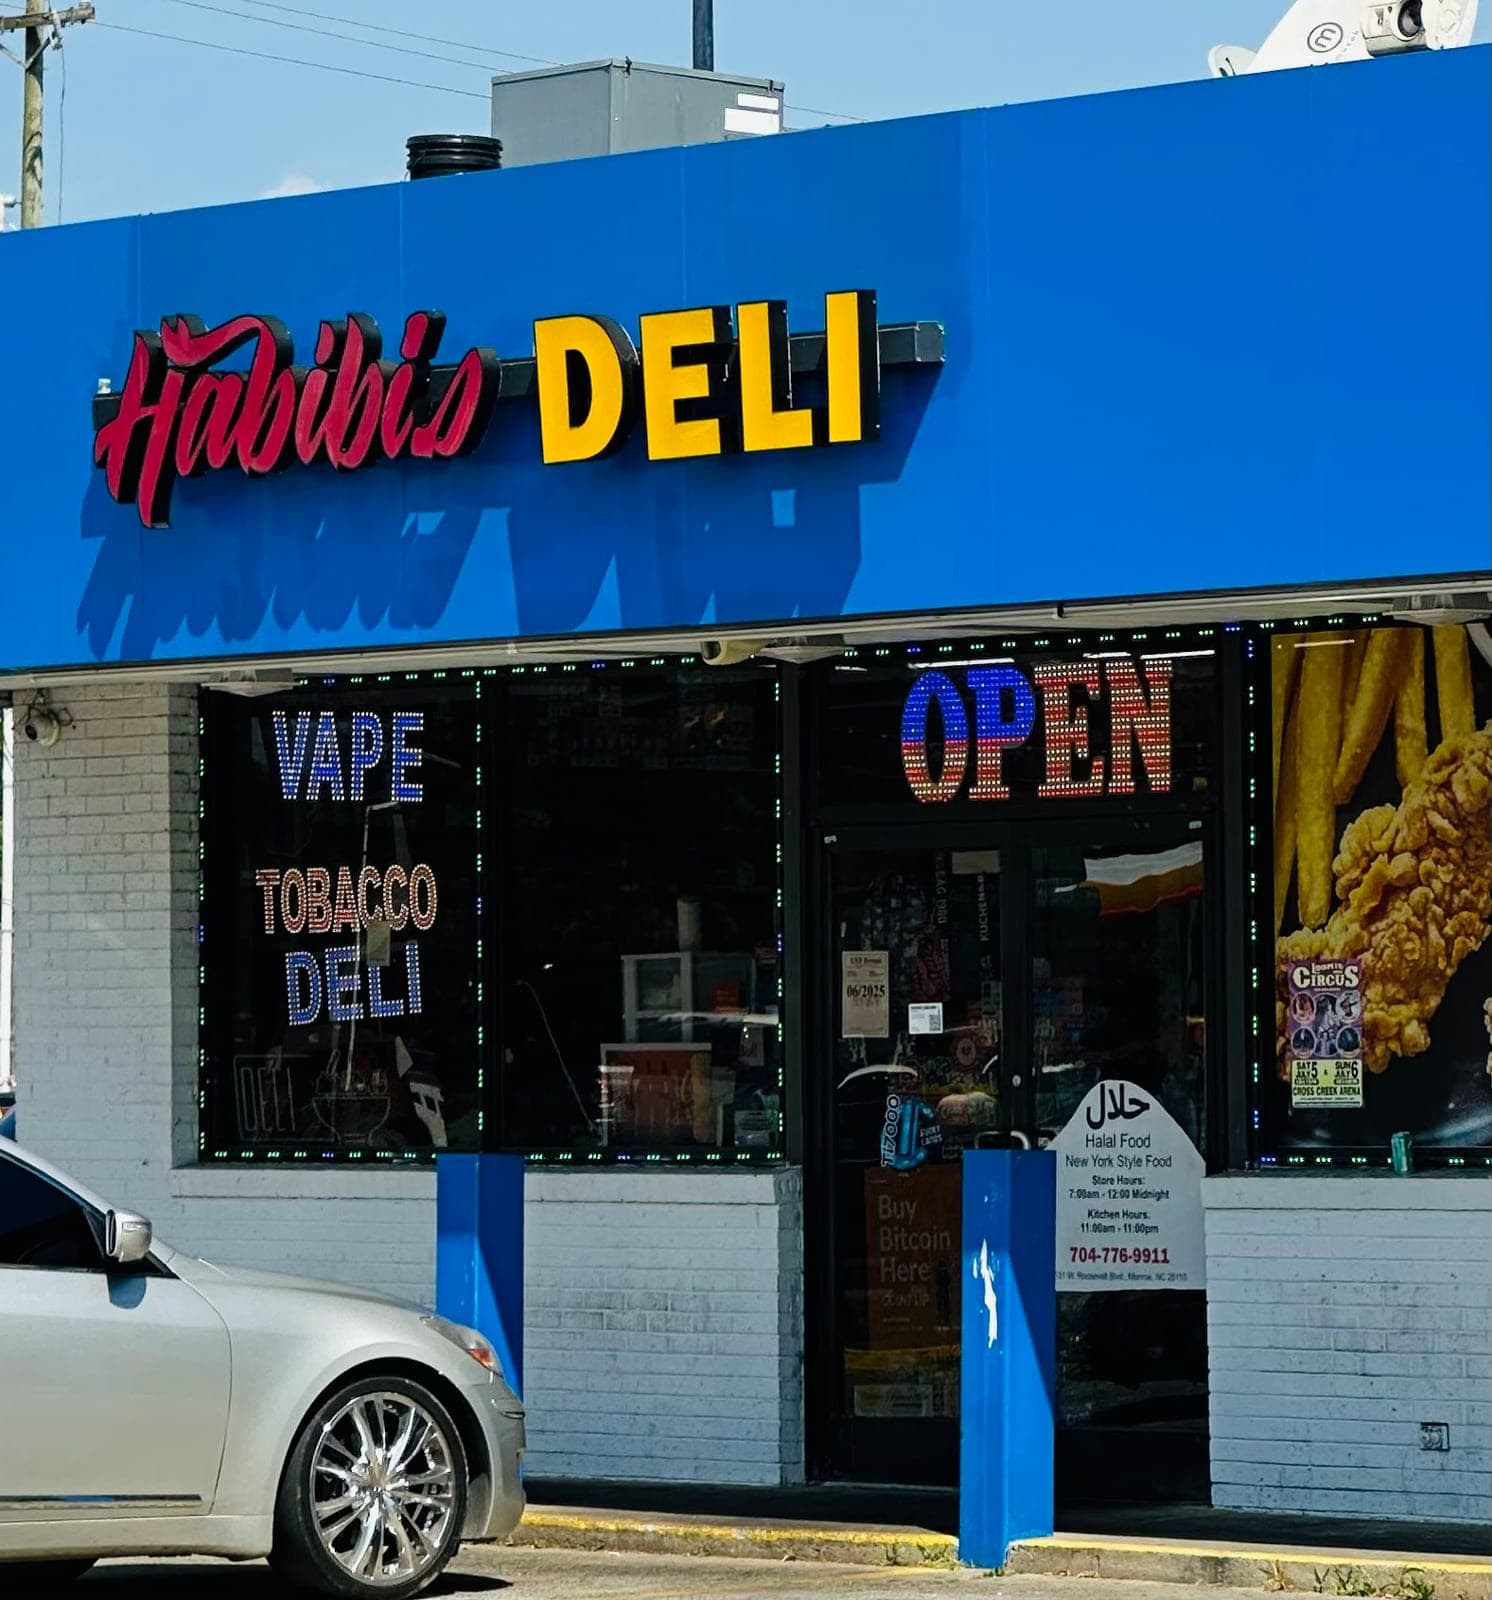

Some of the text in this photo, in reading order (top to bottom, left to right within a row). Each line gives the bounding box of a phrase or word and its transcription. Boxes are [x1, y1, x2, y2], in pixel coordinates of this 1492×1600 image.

[534, 289, 873, 465] DELI
[901, 660, 1173, 803] OPEN
[272, 711, 424, 802] VAPE
[256, 864, 438, 934] TOBACCO
[285, 943, 422, 1026] DELI
[1292, 965, 1359, 988] CIRCUS
[847, 984, 886, 998] 06/2025
[1296, 1061, 1318, 1078] SAT 5
[1351, 1061, 1358, 1078] 6
[1293, 1086, 1360, 1096] CROSS CREEK ARENA
[1087, 1083, 1150, 1130] حلال
[1086, 1132, 1151, 1148] Halal Food
[1066, 1154, 1172, 1170] New York Style Food
[1092, 1175, 1115, 1185] Store
[1069, 1189, 1100, 1199] 7:00am
[1108, 1189, 1130, 1199] 12:00
[1132, 1189, 1169, 1201] Midnight
[879, 1195, 917, 1225] Buy
[1088, 1209, 1120, 1219] Kitchen
[1081, 1223, 1115, 1233] 11:00am
[1123, 1223, 1159, 1235] 11:00pm
[880, 1226, 951, 1252] Bitcoin
[1070, 1247, 1170, 1264] 704-776-9911
[880, 1257, 930, 1284] Here
